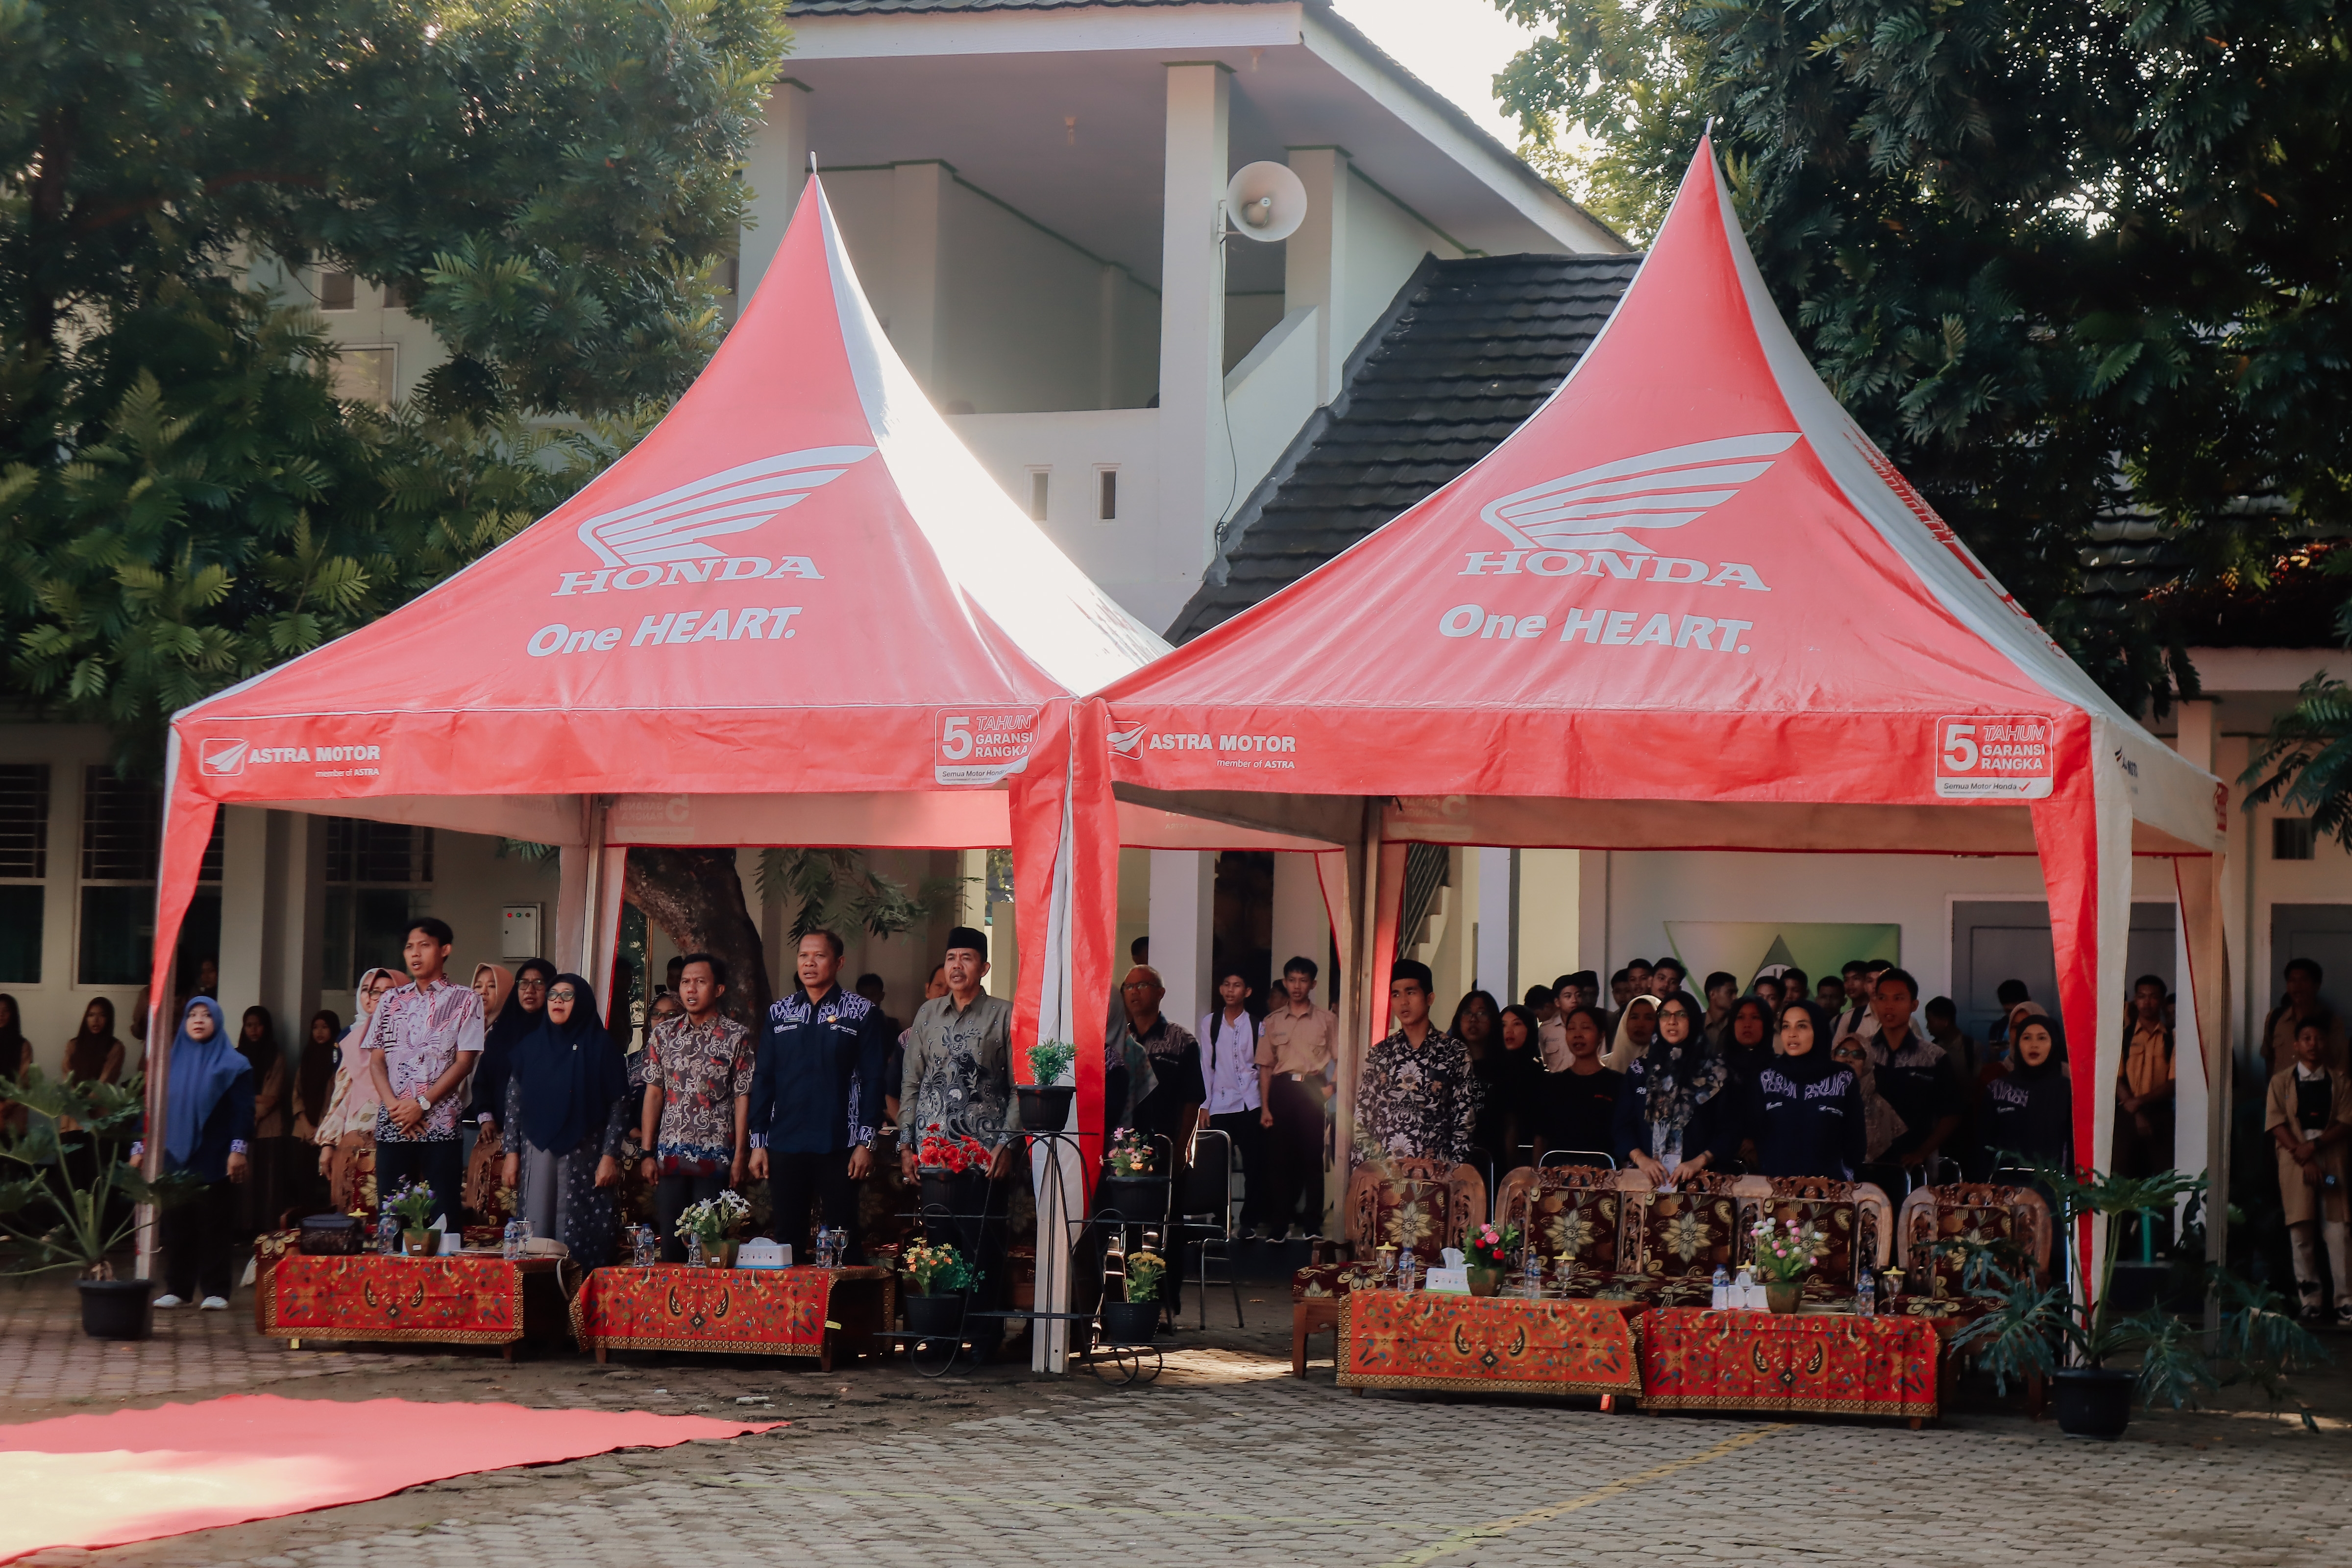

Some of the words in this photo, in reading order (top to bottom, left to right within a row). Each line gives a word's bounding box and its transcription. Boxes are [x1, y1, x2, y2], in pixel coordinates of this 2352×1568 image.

[551, 556, 825, 596] HONDA
[1457, 549, 1772, 591] HONDA
[527, 623, 623, 657] One
[630, 607, 803, 647] HEART.
[1439, 604, 1548, 639] One
[1559, 607, 1754, 654] HEART.
[976, 714, 1032, 731] TAHUN
[942, 716, 973, 760] 5
[975, 732, 1033, 745] GARANSI
[1983, 724, 2046, 741] TAHUN
[975, 745, 1028, 758] RANGKA
[1149, 733, 1213, 750] ASTRA
[1219, 735, 1296, 753] MOTOR
[1944, 724, 1979, 772] 5
[1982, 744, 2045, 756] GARANSI
[248, 747, 311, 764] ASTRA
[315, 745, 380, 762] MOTOR
[354, 767, 380, 776] ASTRA
[1217, 759, 1251, 768] member
[1253, 760, 1264, 768] of
[1264, 760, 1295, 769] ASTRA
[1982, 758, 2043, 770] RANGKA
